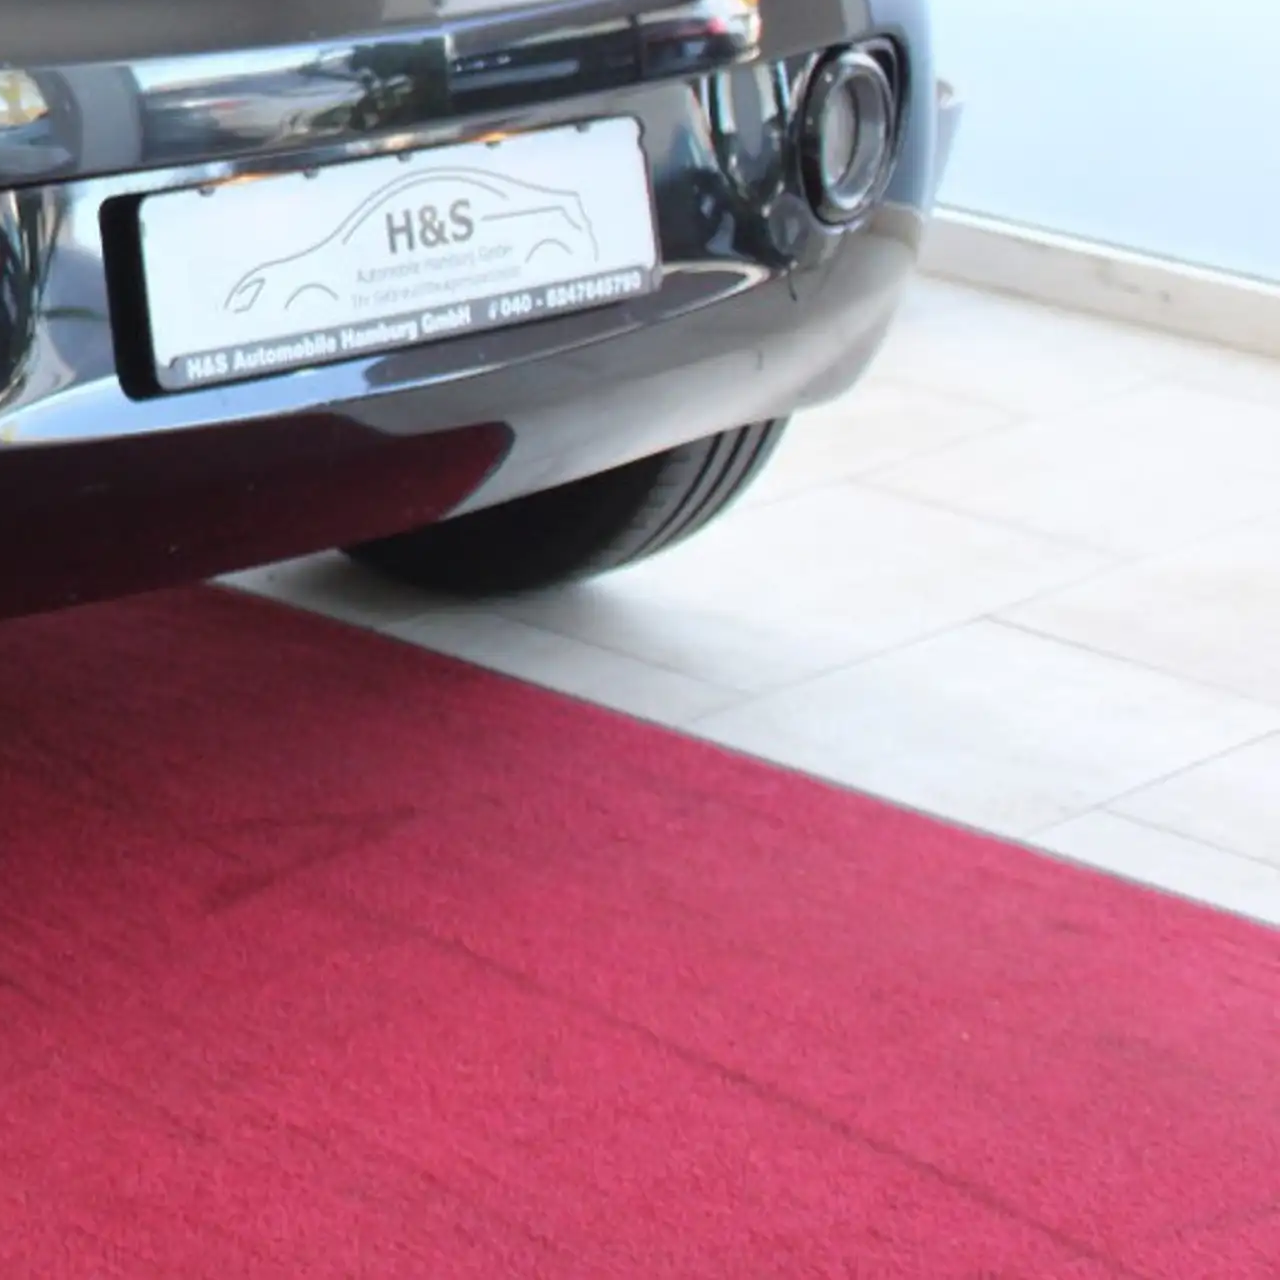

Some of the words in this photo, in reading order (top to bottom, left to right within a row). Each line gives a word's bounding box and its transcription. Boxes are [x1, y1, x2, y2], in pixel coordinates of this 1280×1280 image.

[386, 197, 474, 255] H&S
[186, 352, 228, 379] H&S
[233, 333, 337, 370] Automobile
[341, 319, 418, 350] Hamburg
[421, 304, 471, 333] GmbH
[500, 293, 532, 318] 040
